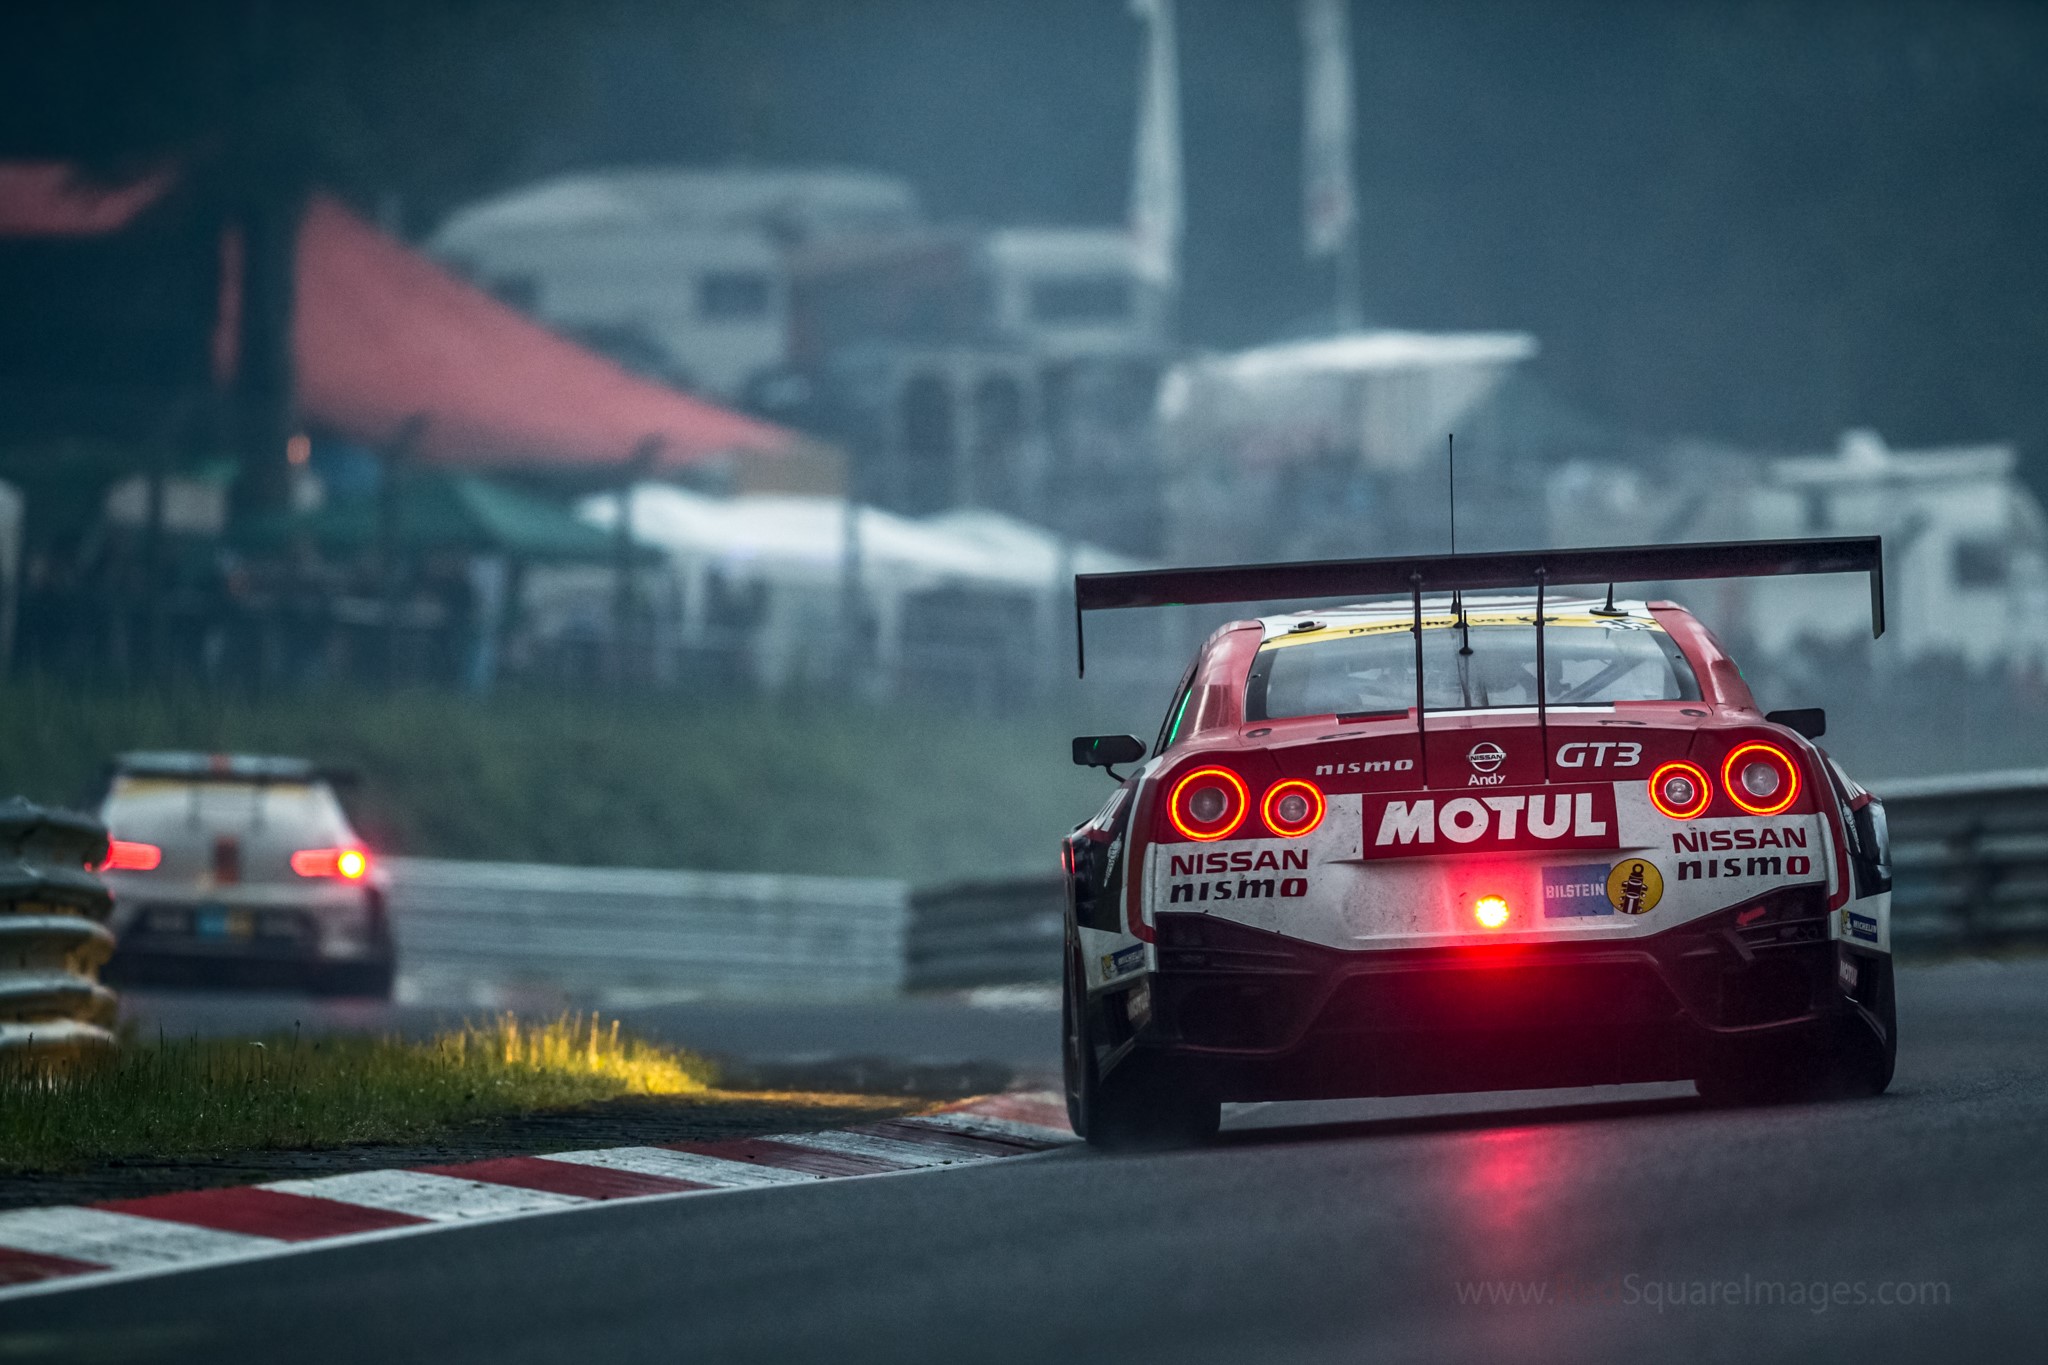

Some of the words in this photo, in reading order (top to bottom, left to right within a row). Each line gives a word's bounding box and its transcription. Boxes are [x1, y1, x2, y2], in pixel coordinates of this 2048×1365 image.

[1470, 753, 1503, 761] NISSAN
[1555, 742, 1643, 768] GT3
[1467, 773, 1506, 786] Andy
[1374, 791, 1606, 846] MOTUL
[1672, 827, 1807, 854] NISSAN
[1170, 848, 1308, 876] NISSAN
[1545, 882, 1605, 899] BILSTEIN
